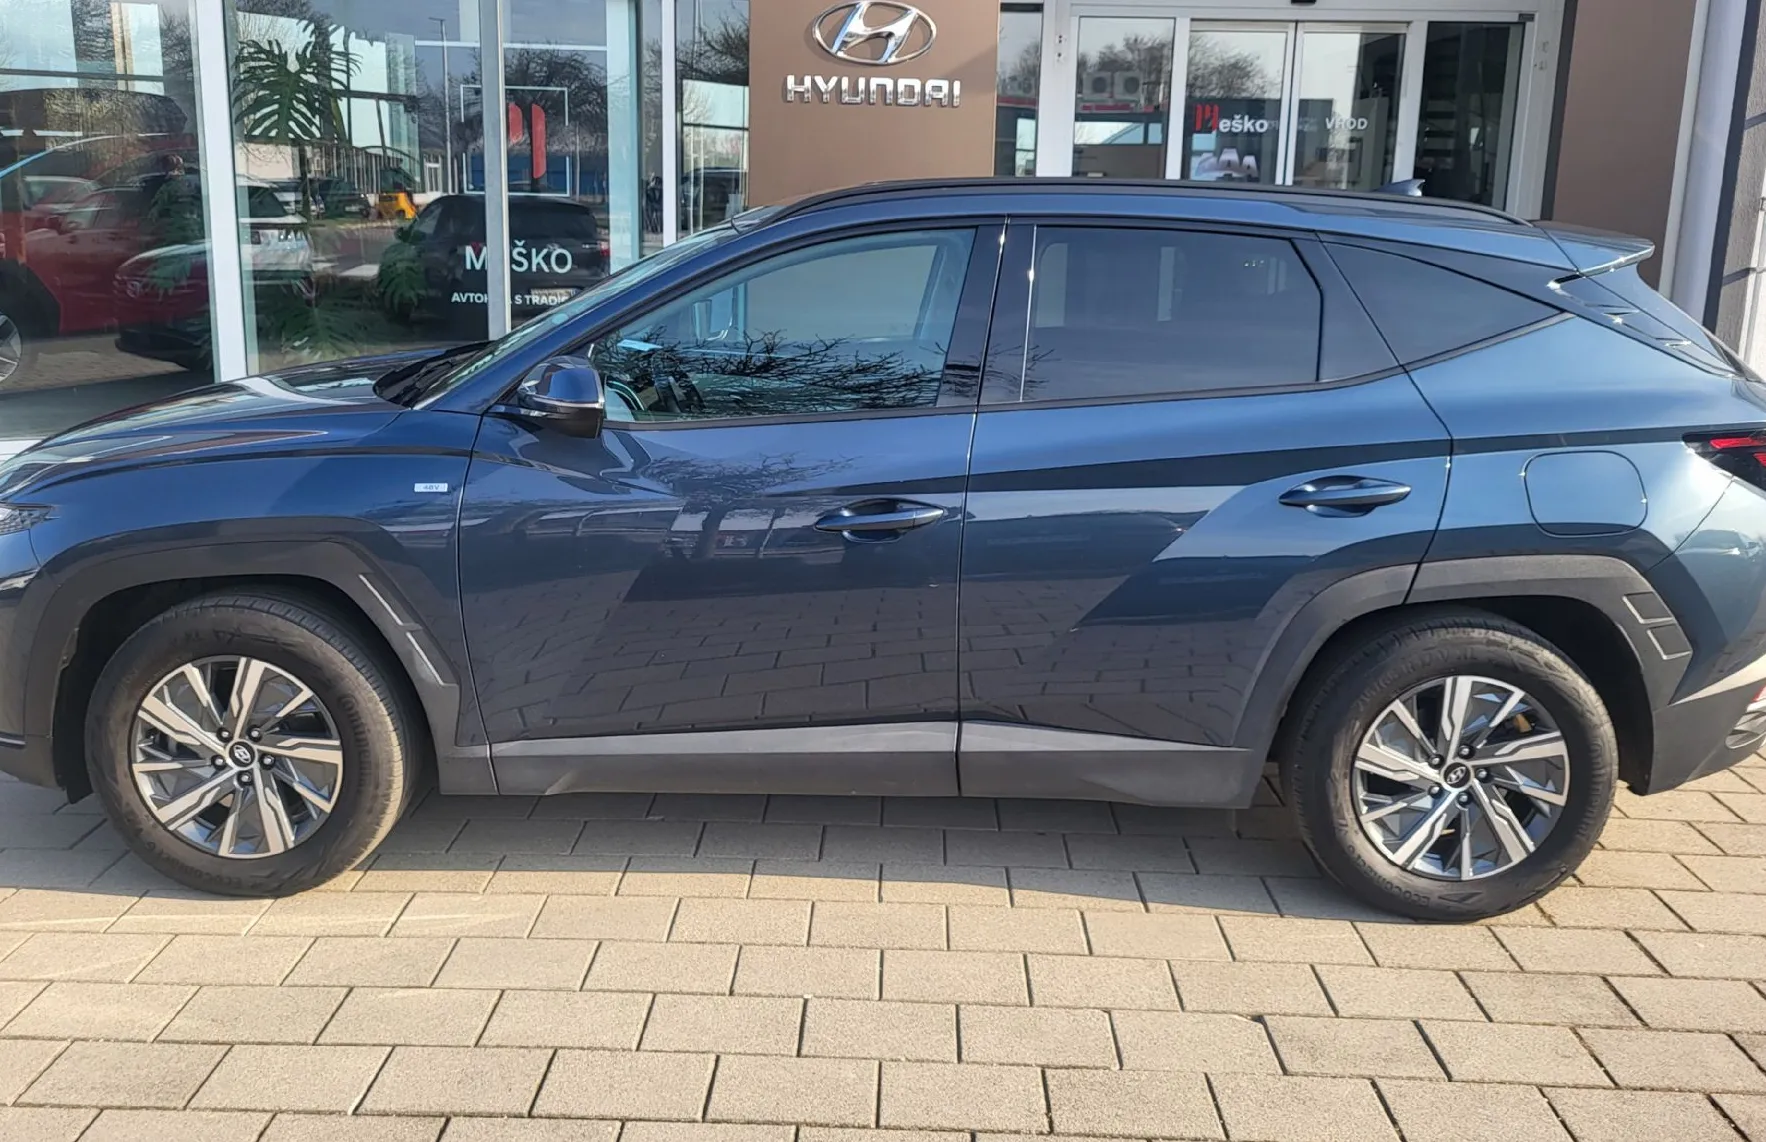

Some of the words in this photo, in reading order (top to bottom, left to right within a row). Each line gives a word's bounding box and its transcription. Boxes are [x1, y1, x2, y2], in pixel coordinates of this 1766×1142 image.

[786, 75, 961, 107] HYUNDAI
[465, 239, 573, 274] MŠKO
[514, 294, 522, 305] S
